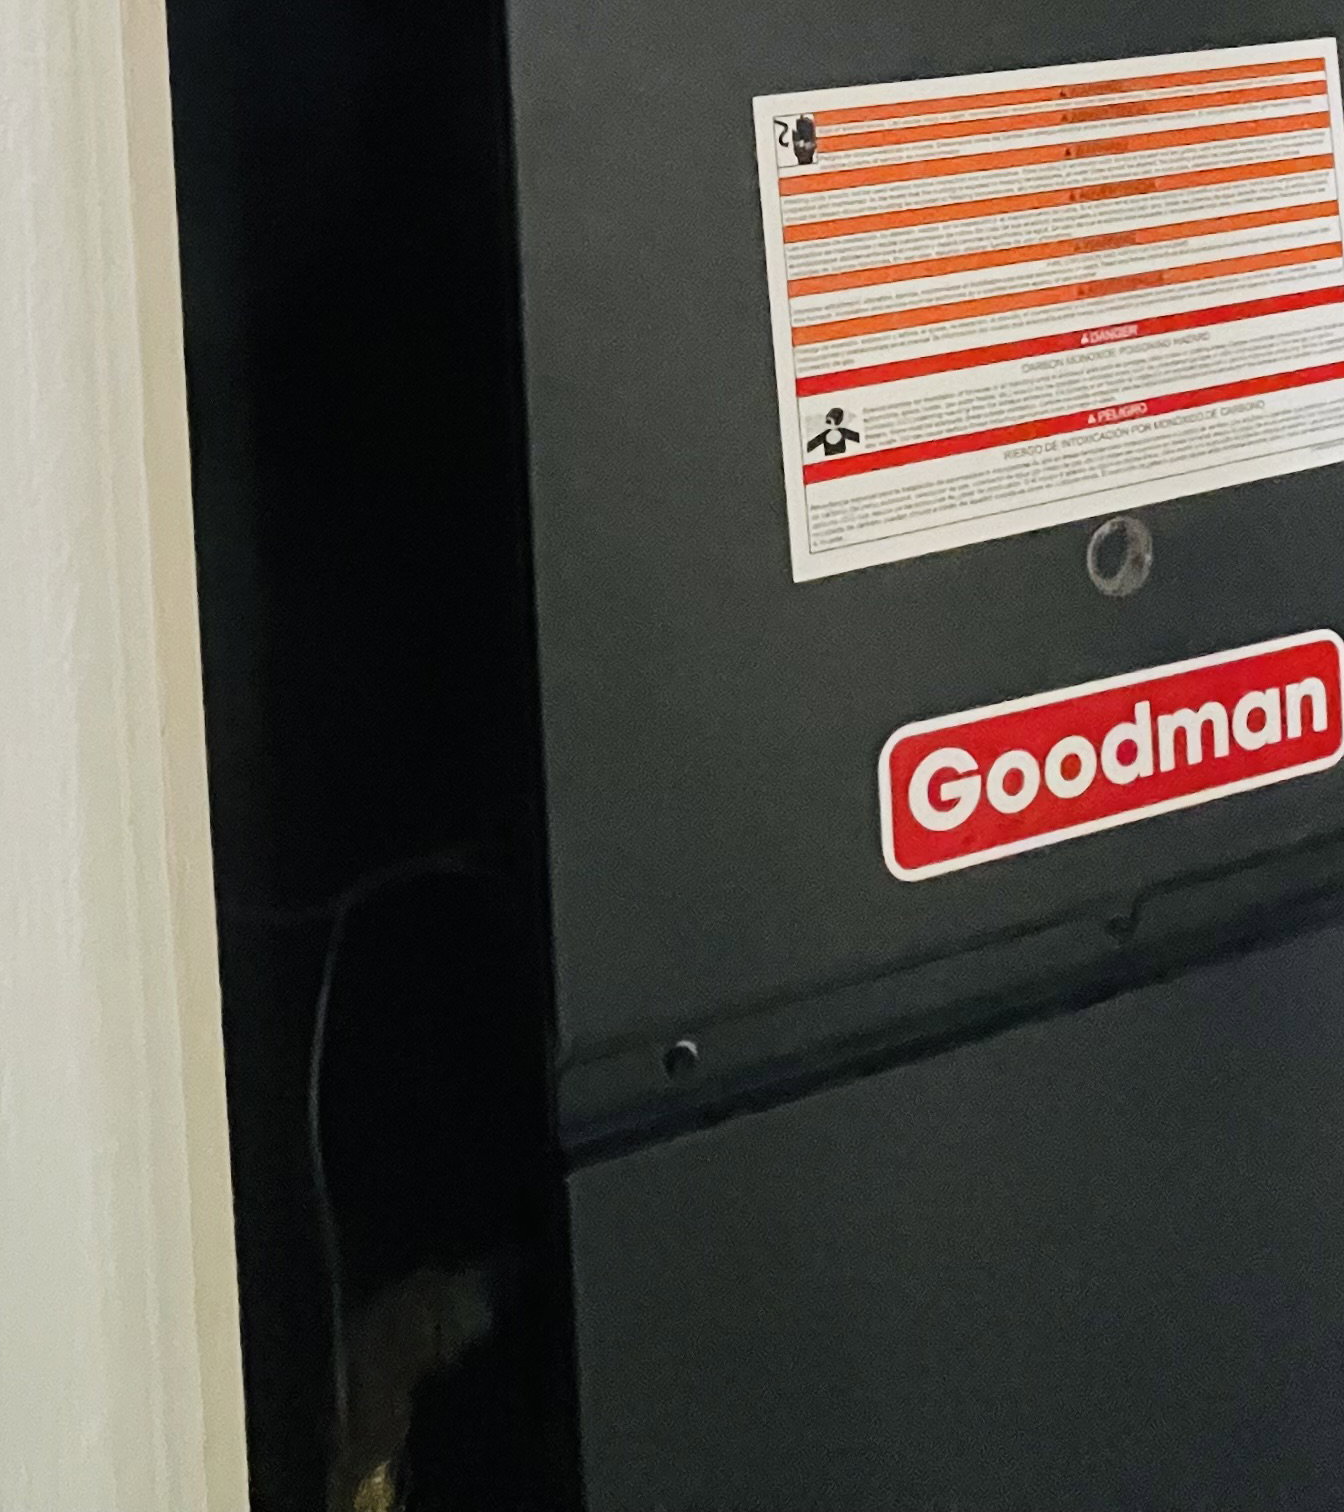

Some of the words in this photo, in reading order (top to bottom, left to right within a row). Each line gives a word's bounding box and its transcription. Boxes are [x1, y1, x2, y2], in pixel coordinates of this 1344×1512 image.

[1089, 324, 1139, 344] DANGER
[1097, 402, 1148, 424] PELIGRO
[1131, 422, 1152, 435] POR
[907, 675, 1328, 832] Goodman
